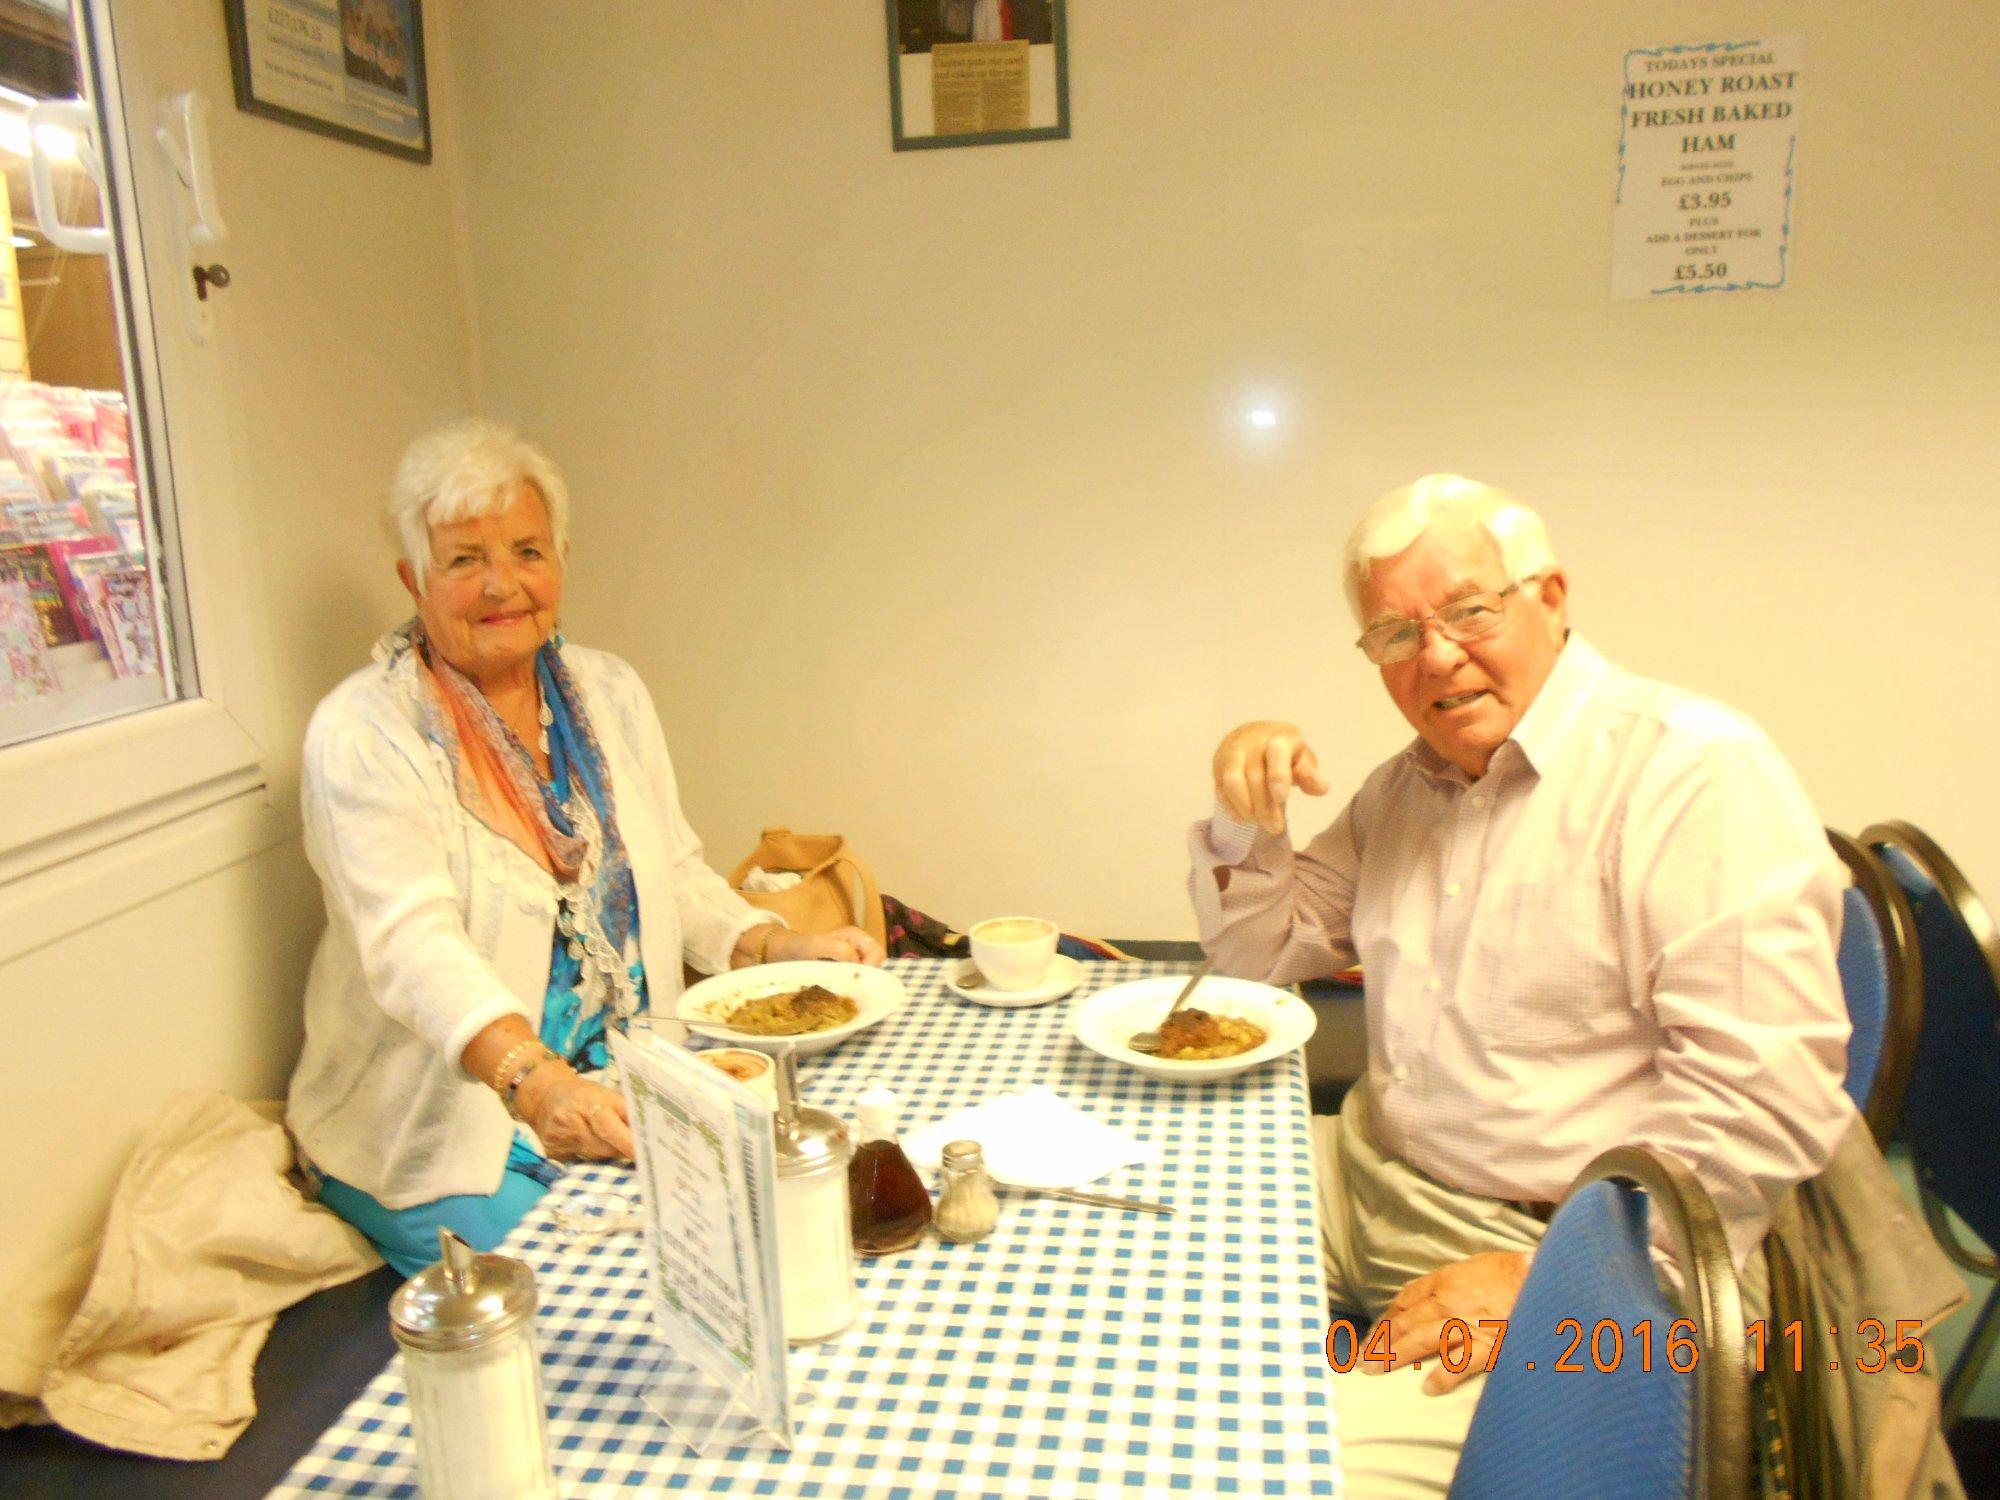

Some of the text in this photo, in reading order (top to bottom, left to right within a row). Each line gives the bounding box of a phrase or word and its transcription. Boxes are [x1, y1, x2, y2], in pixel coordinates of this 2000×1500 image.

[1712, 53, 1774, 66] SPECIAL
[1628, 72, 1796, 99] HONEY ROAST
[1632, 102, 1791, 127] FRESH BAKED
[1682, 134, 1735, 152] HAM
[1661, 171, 1753, 187] EGG AND CHIPS
[1679, 192, 1732, 210] £3.95
[1690, 216, 1720, 228] PLUS
[1645, 233, 1671, 244] ADD
[1684, 229, 1734, 243] DESSERT
[1684, 245, 1718, 256] ONLY
[1675, 263, 1727, 280] £5.50
